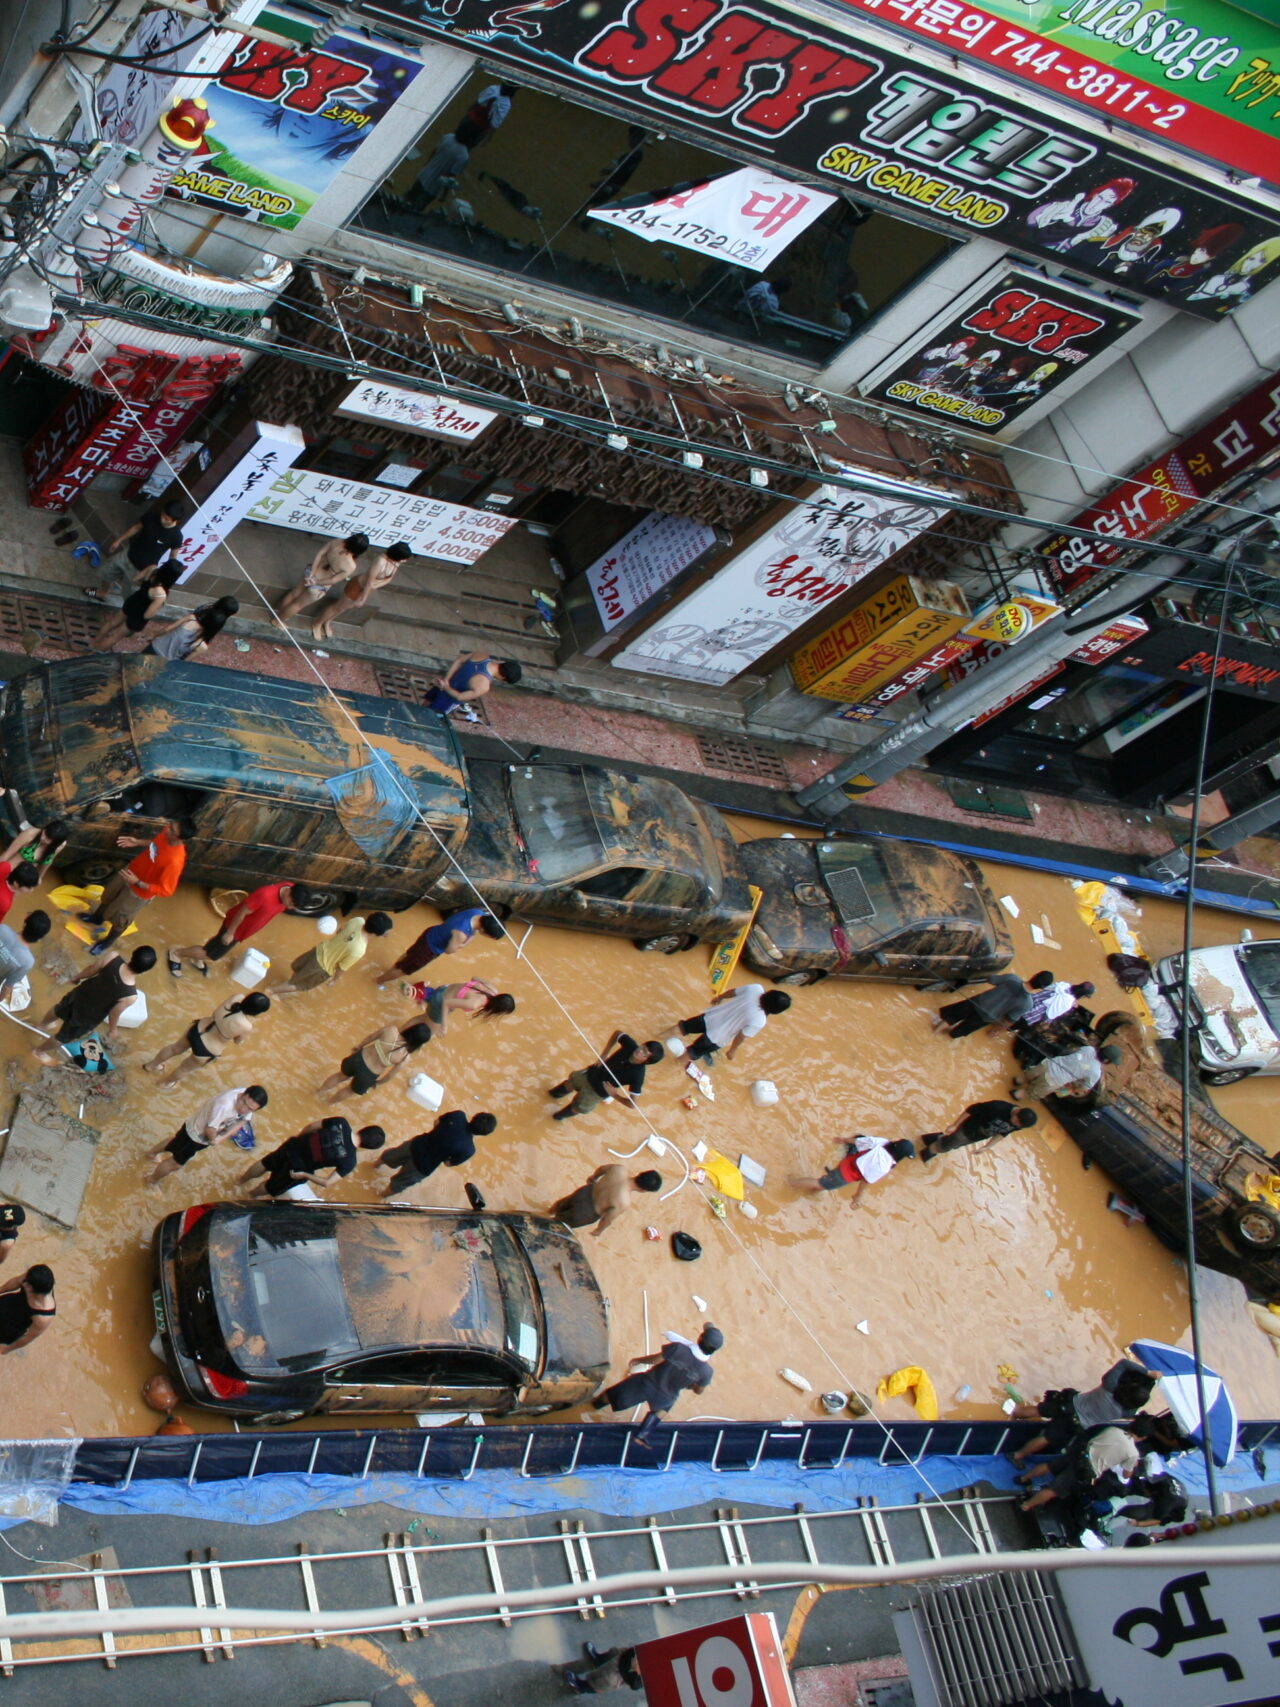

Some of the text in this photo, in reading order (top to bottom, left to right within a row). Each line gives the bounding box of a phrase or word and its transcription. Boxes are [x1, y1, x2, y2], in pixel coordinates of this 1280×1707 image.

[1056, 0, 1242, 83] Massage
[216, 35, 372, 116] KY
[581, 0, 880, 136] SKY
[989, 30, 1188, 130] 744-3811~2
[322, 103, 371, 130] 스카이
[864, 72, 1096, 198] 게임랜드
[229, 181, 294, 216] LAND
[821, 146, 1009, 227] SKY GAME LAND
[963, 289, 1105, 352] SKY
[885, 381, 1006, 426] SKY GAME LAND
[1188, 451, 1214, 476] 2F
[298, 494, 434, 534] 소불고기덮밥
[315, 478, 449, 519] 돼지불고기덮밥
[765, 554, 849, 605] 황제
[888, 614, 939, 658] 오아시스
[1006, 604, 1024, 628] DVD
[866, 642, 916, 665] MOTEL
[877, 646, 947, 703] 노래방
